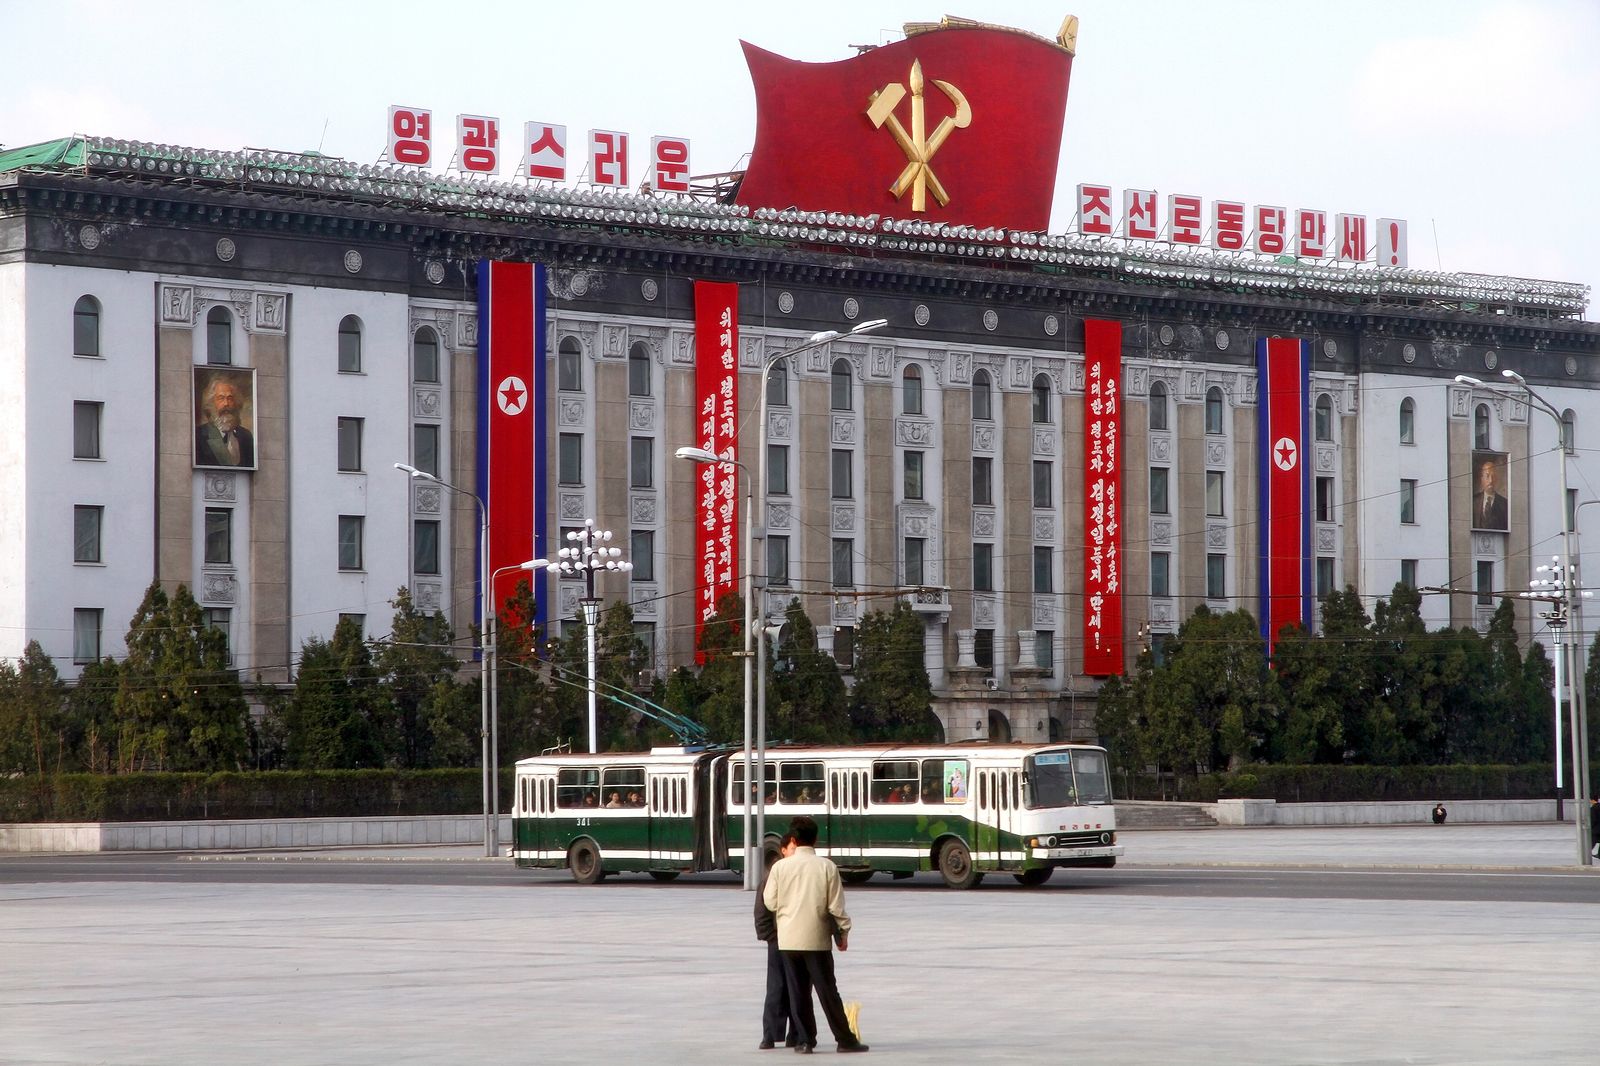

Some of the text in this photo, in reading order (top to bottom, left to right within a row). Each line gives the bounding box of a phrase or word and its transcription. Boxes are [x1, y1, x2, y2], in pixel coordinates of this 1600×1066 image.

[393, 109, 690, 191] 영광스러운
[702, 464, 718, 531] 영광을
[717, 306, 736, 588] 위대한 령도자 김정일동지께
[1087, 361, 1105, 650] 위대한 령도자 김정일동지 만세!
[1104, 378, 1119, 594] 우리 운명의 영원한 수호자
[702, 539, 718, 621] 드립니다
